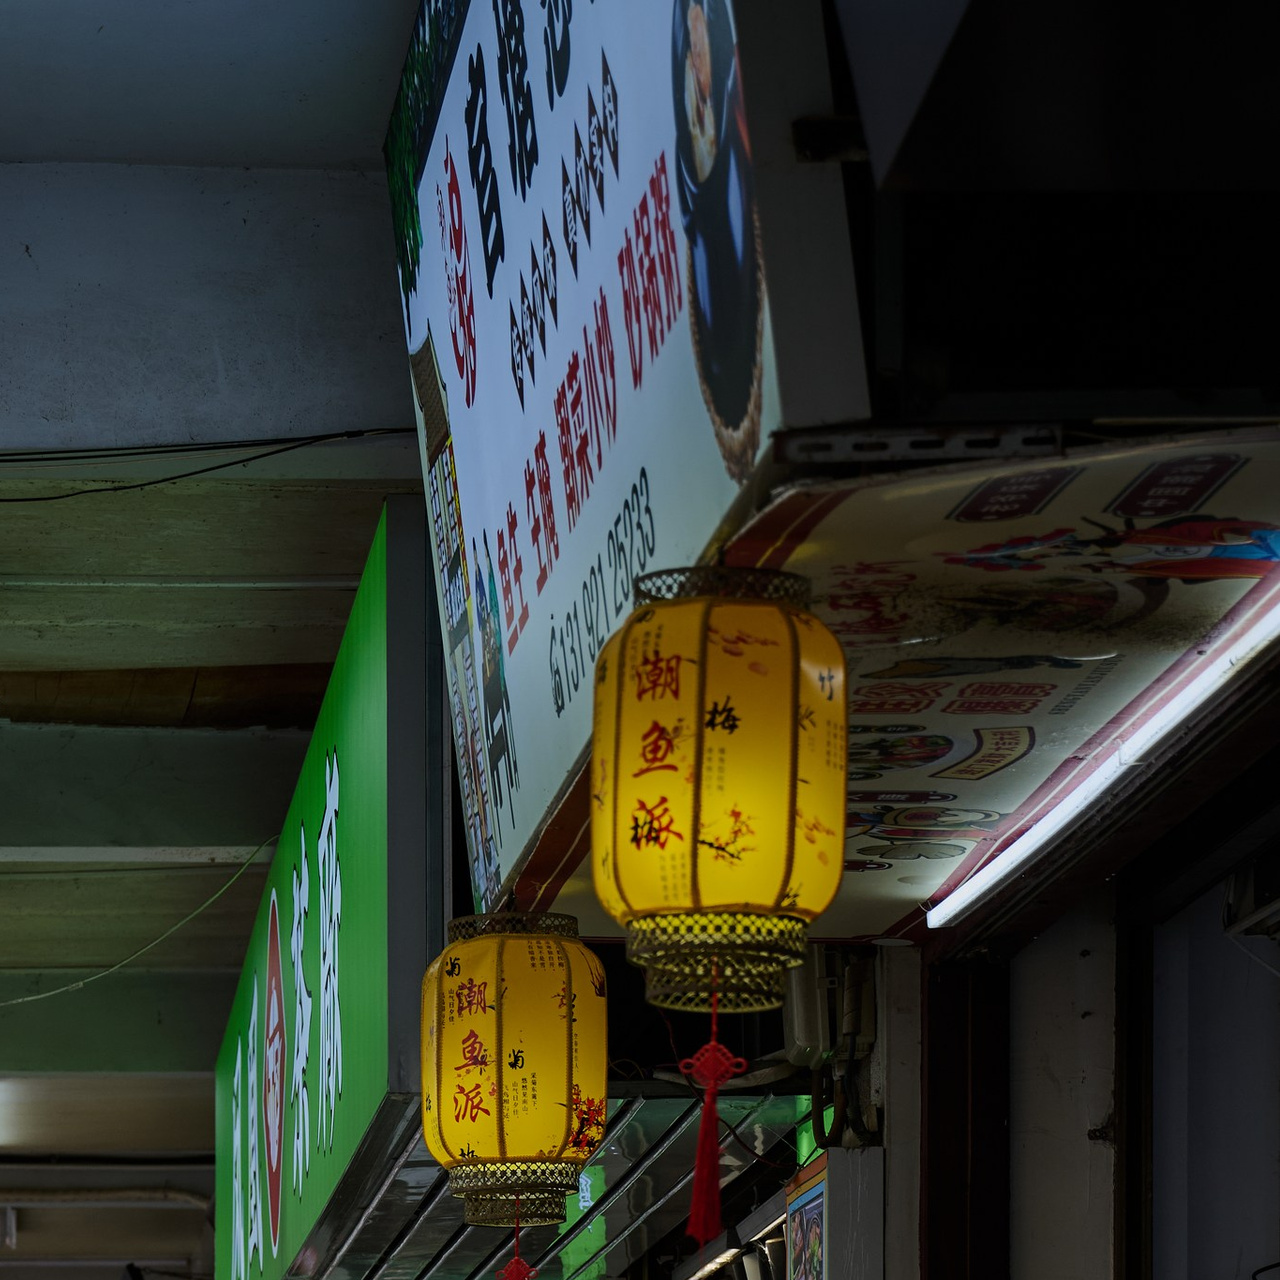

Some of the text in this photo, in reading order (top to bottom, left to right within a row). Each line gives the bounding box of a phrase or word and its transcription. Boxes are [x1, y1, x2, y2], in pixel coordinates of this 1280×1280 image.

[617, 148, 684, 392] 砂锅粥
[558, 465, 657, 706] 131 921 25233
[631, 650, 684, 850] 潮鱼派
[453, 978, 491, 1124] 潮鱼派
